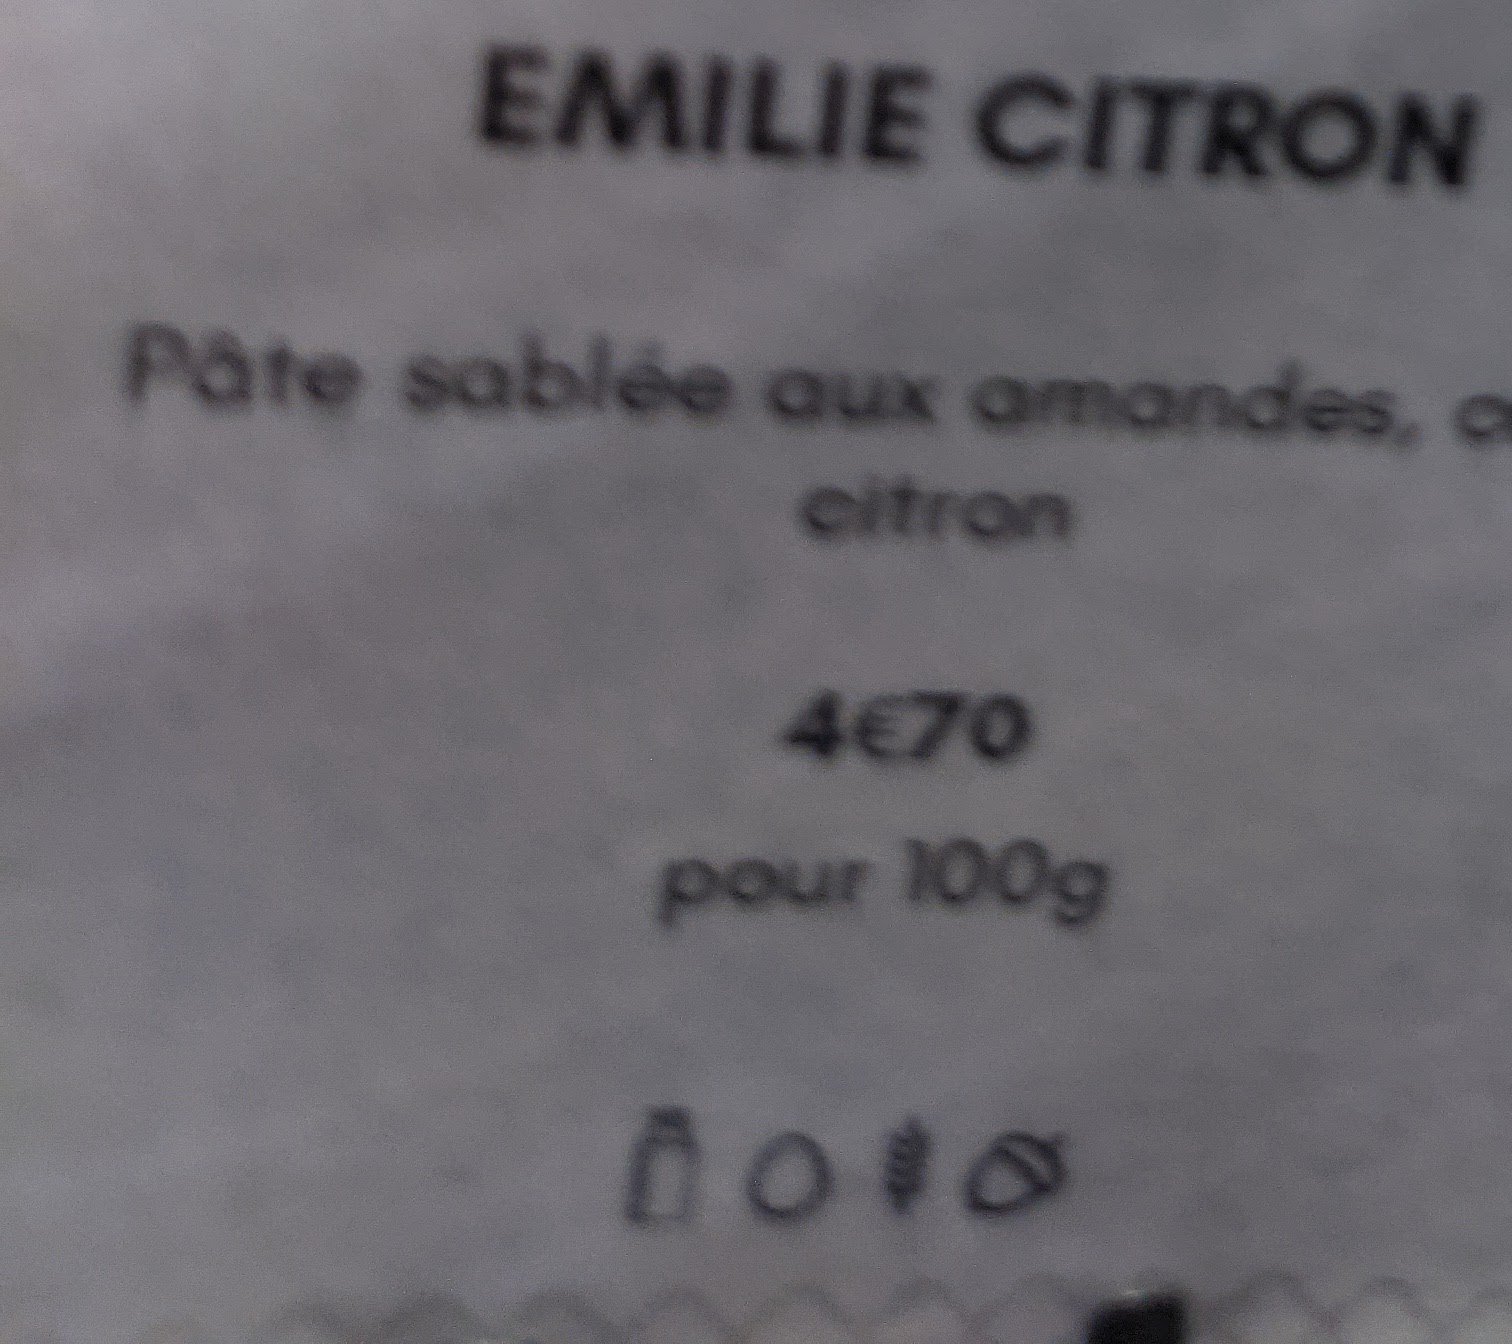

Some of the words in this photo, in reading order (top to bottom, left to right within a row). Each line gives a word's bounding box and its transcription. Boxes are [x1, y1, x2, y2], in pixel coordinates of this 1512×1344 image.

[475, 42, 931, 166] EMILIE
[973, 73, 1484, 191] CITRON
[122, 320, 365, 414] Pâte
[402, 331, 735, 421] sablée
[763, 366, 938, 429] aux
[972, 360, 1417, 452] amandes,
[797, 475, 1074, 545] citron
[781, 689, 1034, 764] 4€70
[656, 856, 868, 932] pour
[903, 836, 1114, 932] 100g
